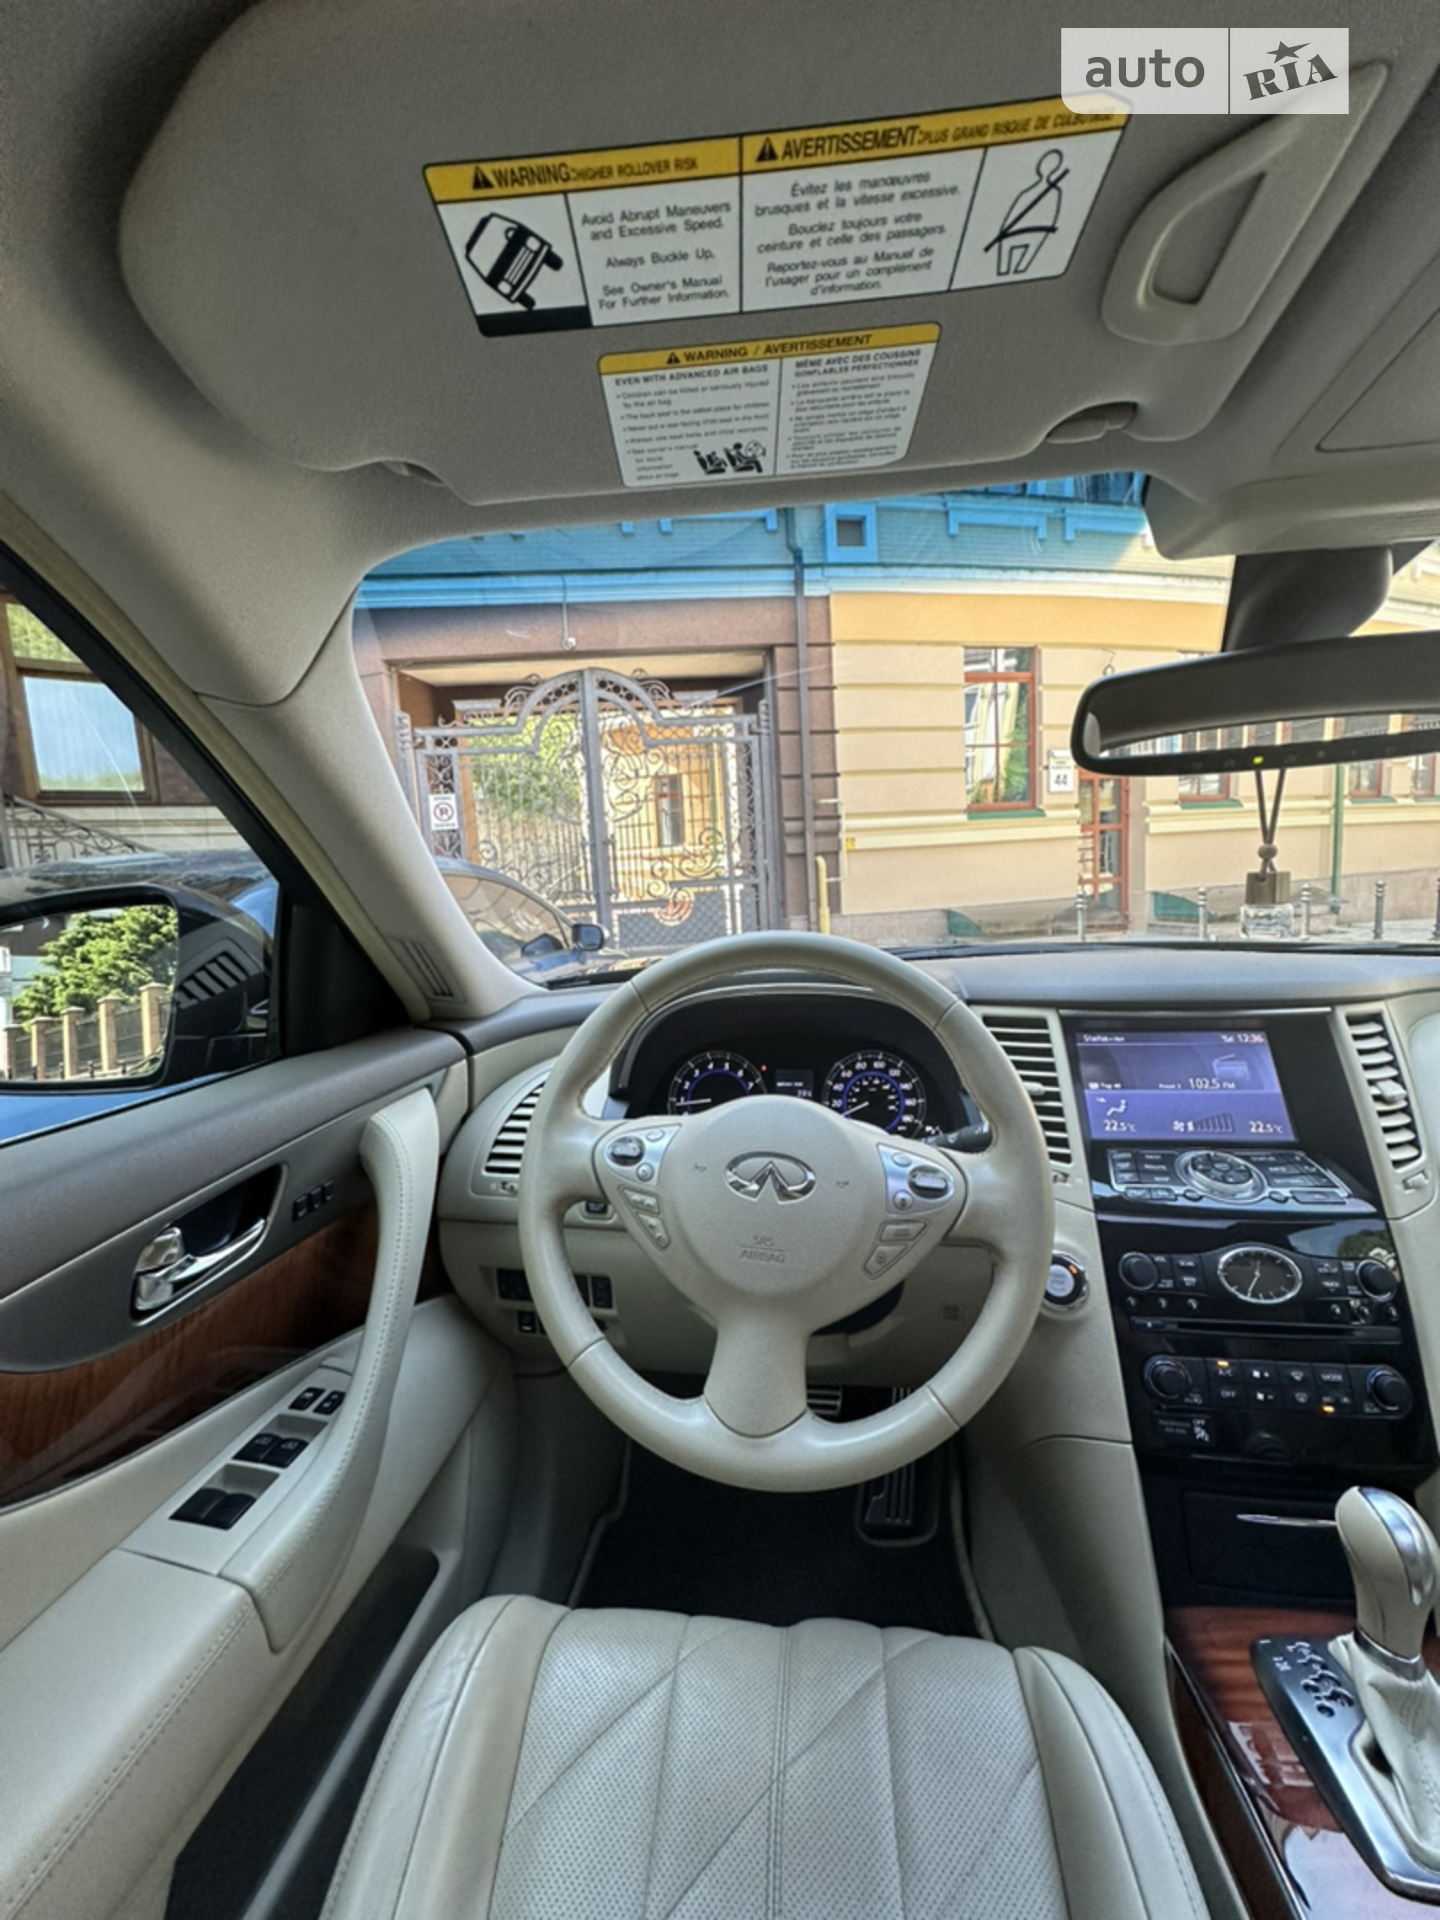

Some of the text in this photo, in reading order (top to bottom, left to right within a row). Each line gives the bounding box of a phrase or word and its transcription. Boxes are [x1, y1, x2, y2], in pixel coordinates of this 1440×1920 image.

[952, 124, 989, 141] GRAND
[991, 118, 1031, 136] RISQUE
[1034, 116, 1050, 130] DE
[617, 159, 672, 178] ROLLOVER
[674, 156, 698, 172] RISK
[790, 180, 828, 198] Évitez
[834, 179, 852, 192] les
[754, 184, 961, 218] brusques et la vitesse excessive.
[581, 201, 732, 226] Avoid Abrupt Maneuvers
[788, 211, 922, 236] Bouclez toujours votre
[590, 216, 724, 241] and Excessive Speed.
[757, 224, 946, 254] ceinture et celle des passagers.
[606, 248, 715, 269] Always Buckle Up.
[767, 246, 934, 274] Reportez-vous au Manuel de
[765, 260, 932, 288] l'usager pour un complément
[602, 275, 722, 297] See Owner's Manual
[810, 281, 882, 296] d'information.
[598, 288, 730, 310] For Further Information.
[684, 346, 748, 362] WARNING
[763, 334, 873, 355] AVERTISSEMENT
[825, 355, 850, 366] AVEC
[852, 353, 871, 364] DES
[615, 364, 769, 386] EVEN WITH ADVANCED AIR BAGS
[1188, 1078, 1221, 1090] 102.5
